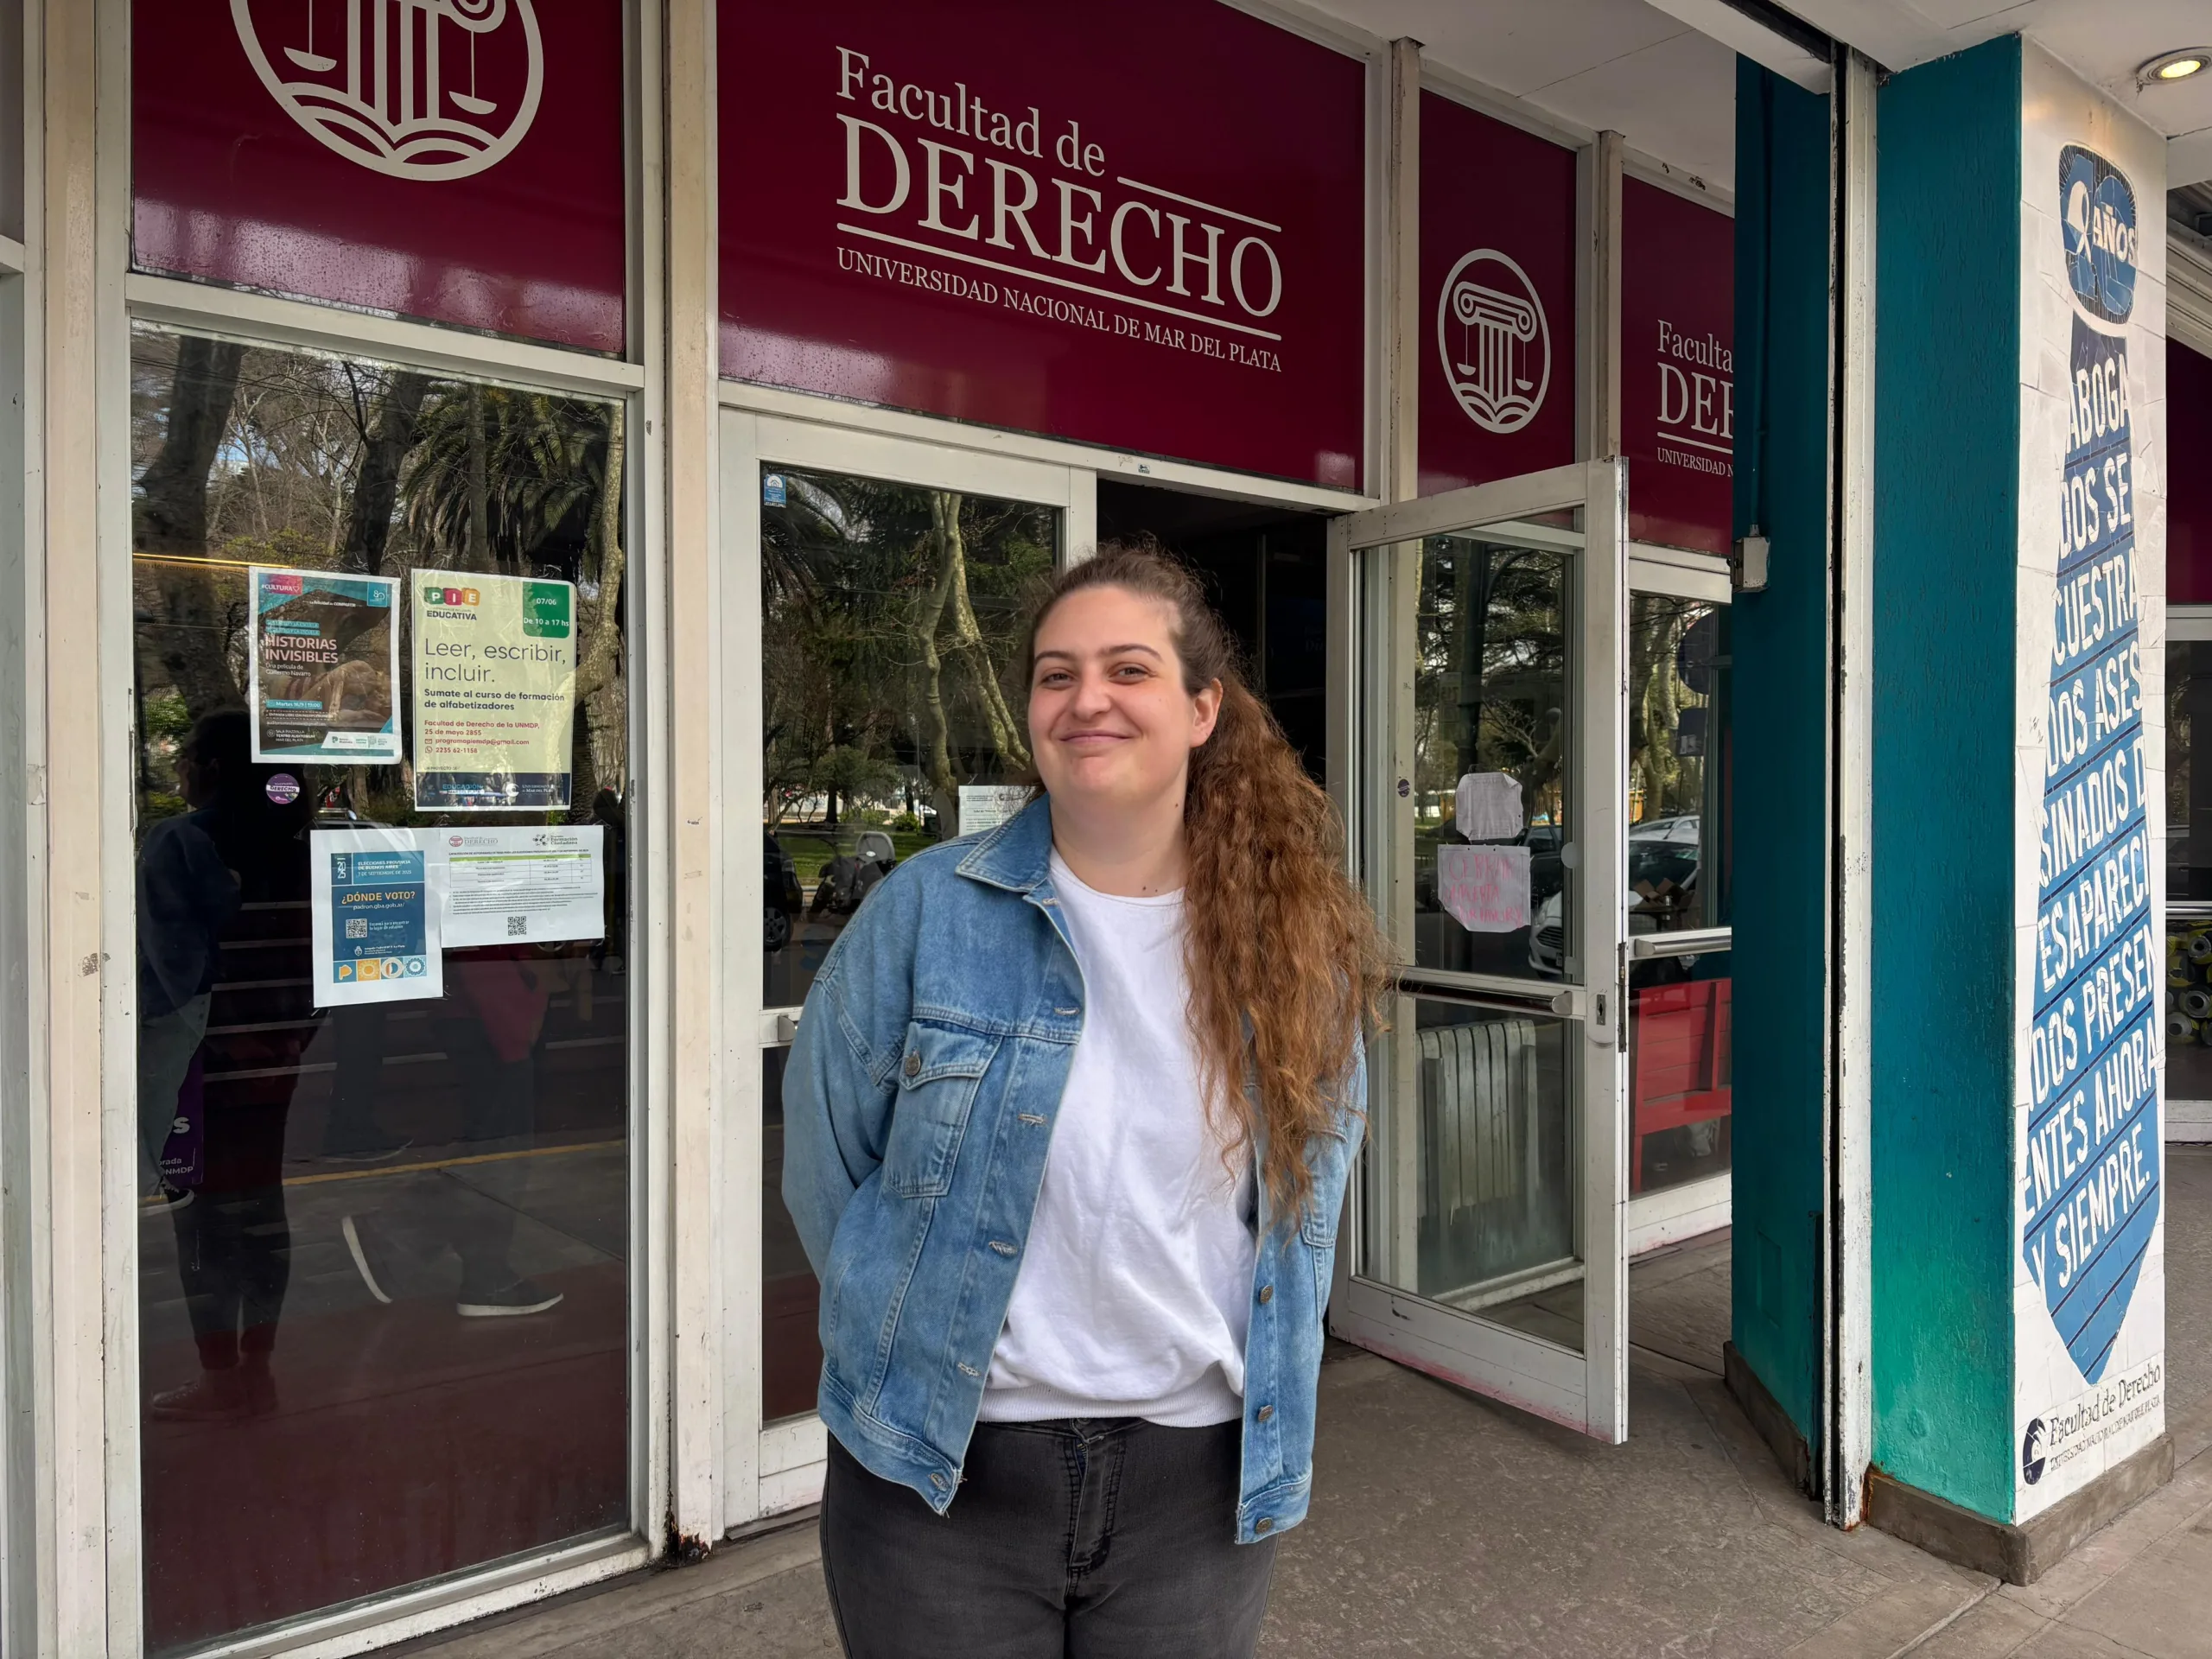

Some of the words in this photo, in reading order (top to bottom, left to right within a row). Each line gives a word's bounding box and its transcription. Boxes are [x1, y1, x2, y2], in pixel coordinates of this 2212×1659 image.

[836, 45, 1043, 159] Facultad
[1056, 119, 1106, 177] de
[836, 112, 1282, 317] DERECHO
[2093, 201, 2137, 262] AÑOS
[836, 246, 999, 305] UNIVERSIDAD
[1002, 287, 1110, 332] NACIONAL
[1114, 314, 1141, 339] DE
[1144, 321, 1187, 350] MAR
[1190, 334, 1226, 360] DEL
[1228, 343, 1283, 372] PLATA
[1657, 319, 1733, 373] Faculta
[2065, 353, 2130, 454] ABOGA
[1657, 448, 1726, 475] UNIVERSIDAD
[2060, 466, 2101, 560] DOS
[2103, 451, 2132, 533] SE
[426, 610, 477, 621] EDUCATIVA
[431, 592, 477, 603] PIE
[536, 597, 557, 606] 07/06
[2051, 546, 2138, 666] CUESTRA
[265, 635, 338, 650] HISTORIAS
[265, 648, 339, 664] INVISIBLES
[425, 638, 476, 660] Leer,
[484, 644, 566, 665] escribir,
[425, 662, 496, 683] incluir.
[424, 689, 461, 698] Sumate
[463, 690, 473, 698] al
[505, 691, 517, 700] de
[518, 691, 565, 702] formación
[424, 699, 436, 709] de
[439, 700, 515, 711] alfabetizadores
[2047, 678, 2088, 778] DOS
[2094, 641, 2143, 741] ASES
[2037, 748, 2129, 889] SINADOS
[2133, 734, 2146, 809] D
[341, 891, 383, 905] ¿DÓNDE
[385, 891, 416, 900] VOTO?
[2037, 829, 2150, 994] ESAPARECI
[2094, 1016, 2164, 1146] AHORA
[2031, 1233, 2046, 1296] Y
[2056, 1122, 2151, 1289] SIEMPRE.
[2050, 1393, 2101, 1446] Facultad
[2101, 1388, 2116, 1417] de
[2118, 1363, 2161, 1408] Derecho
